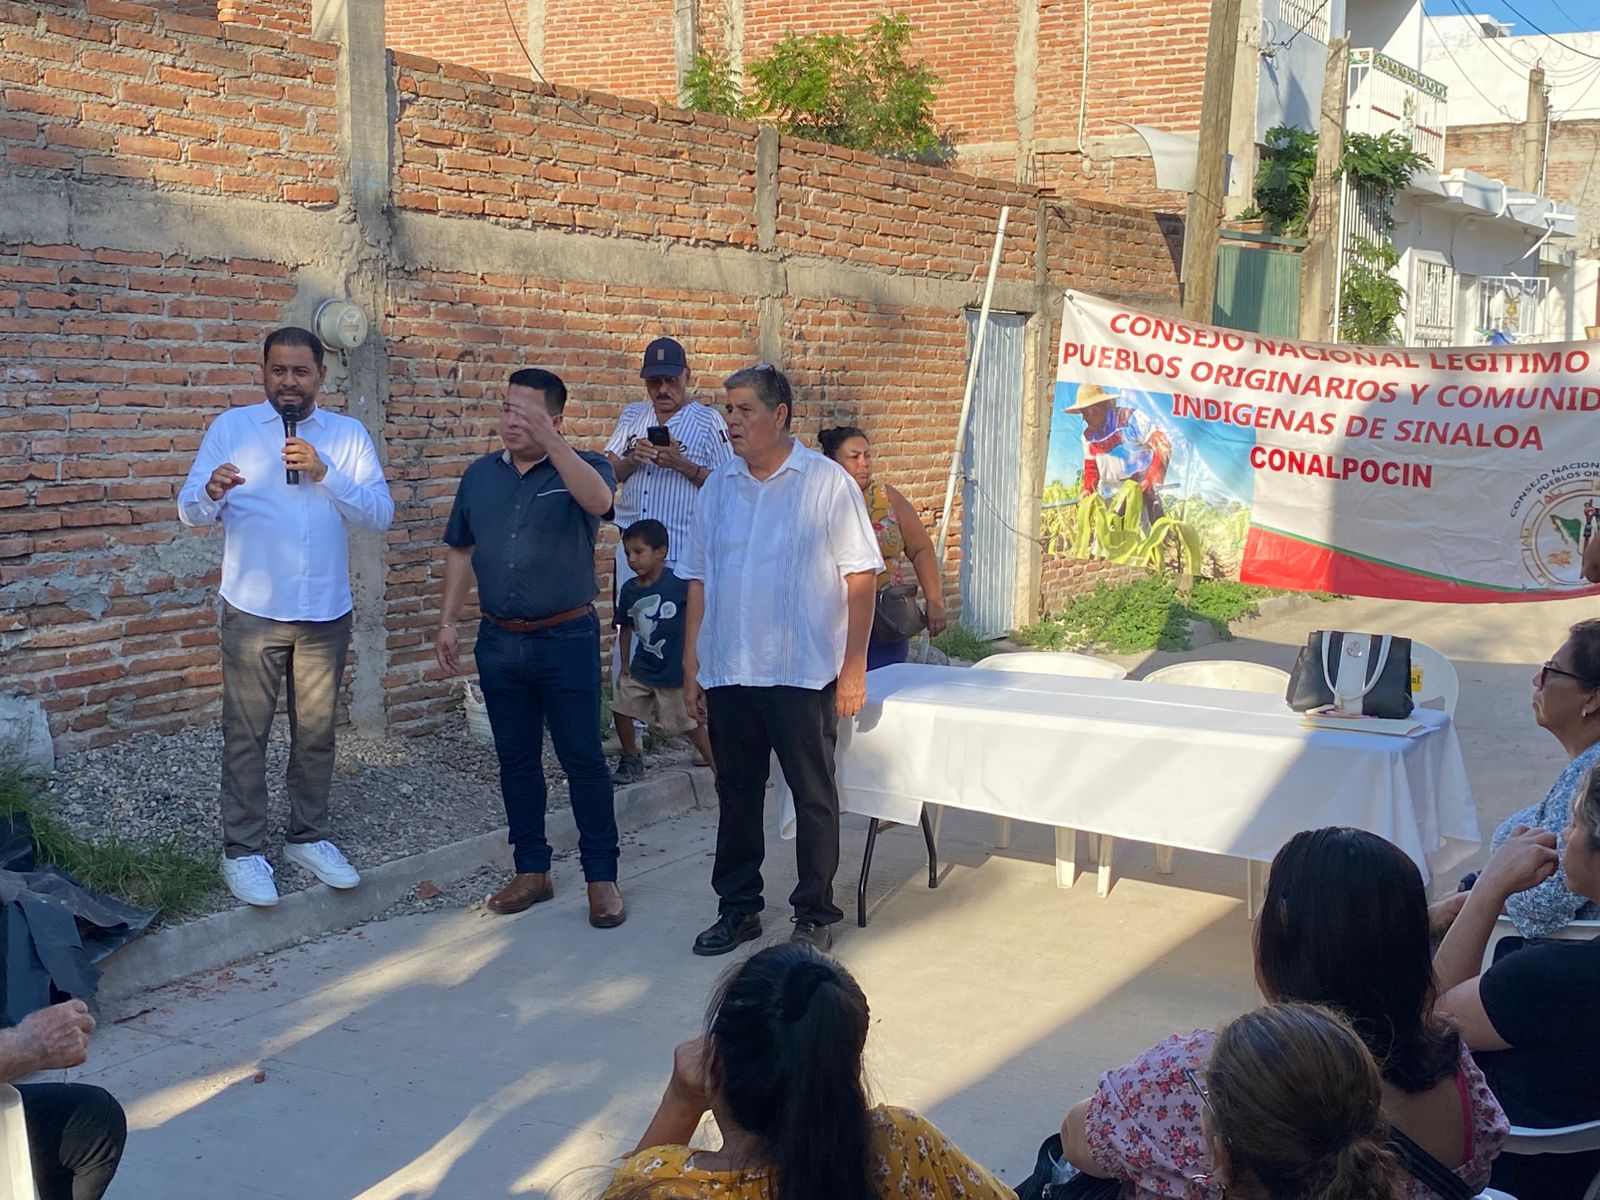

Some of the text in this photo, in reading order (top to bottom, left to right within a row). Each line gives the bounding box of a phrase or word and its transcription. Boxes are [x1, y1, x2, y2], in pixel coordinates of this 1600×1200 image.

[1110, 313, 1590, 373] CONSEJO NACIONAL LEGITIMO
[1063, 342, 1600, 411] PUEBLOS ORIGINARIOS Y COMUNID
[1172, 393, 1544, 450] INDIGENAS DE SINALOA
[1250, 445, 1433, 488] CONALPOCIN
[1536, 471, 1581, 494] PUEBLOS
[1510, 473, 1549, 518] CONSEJO
